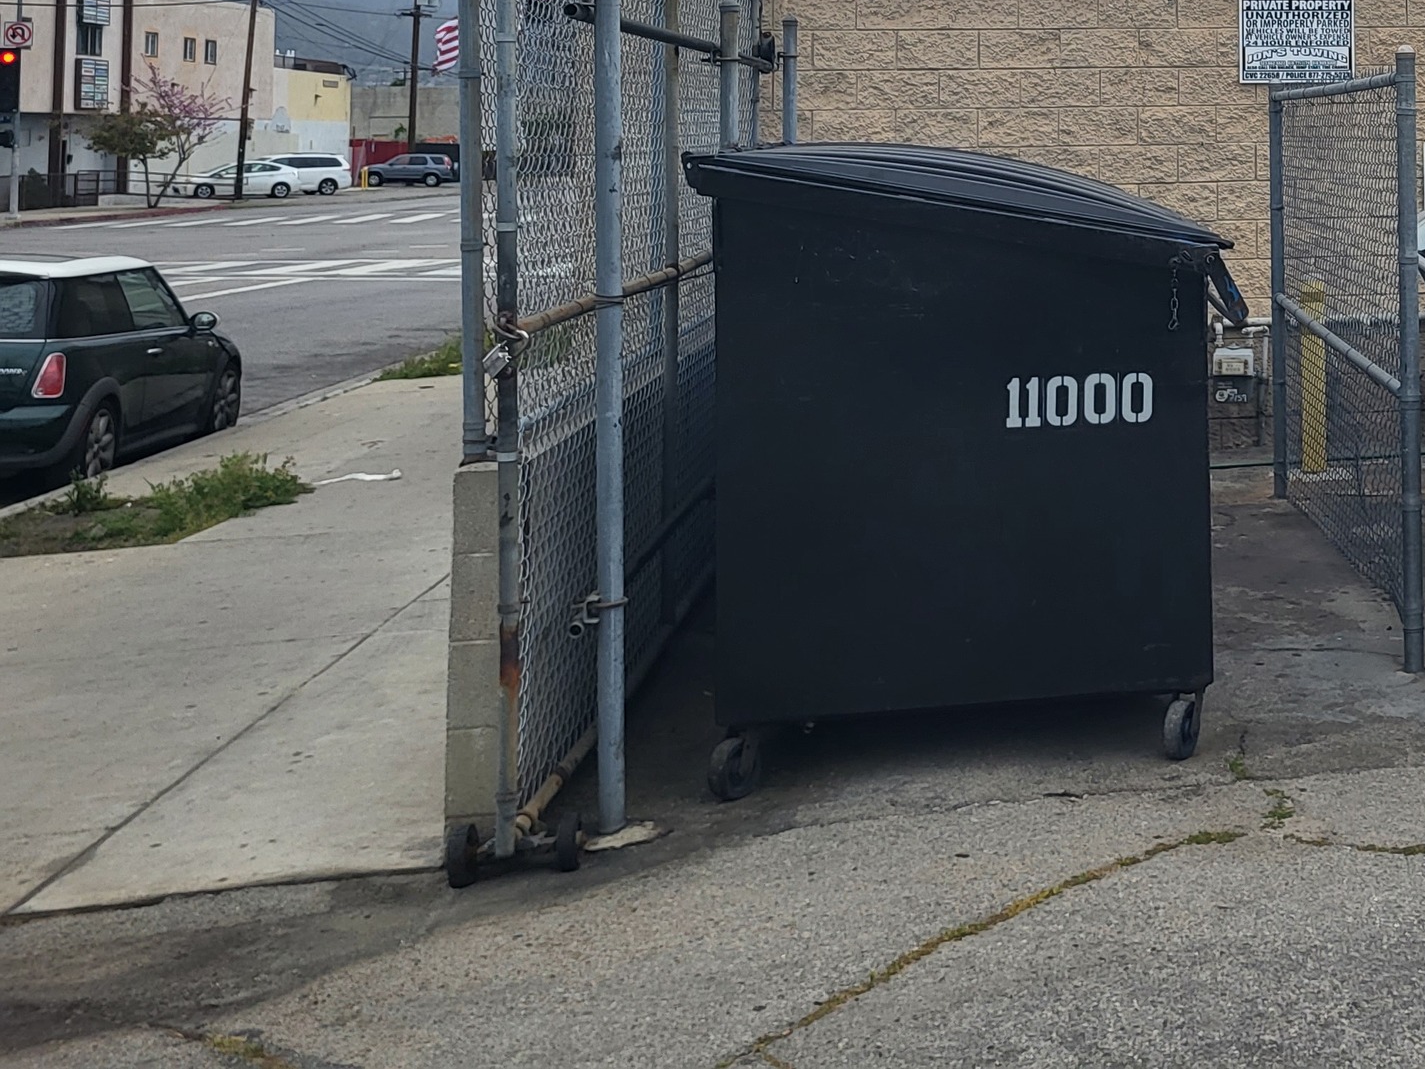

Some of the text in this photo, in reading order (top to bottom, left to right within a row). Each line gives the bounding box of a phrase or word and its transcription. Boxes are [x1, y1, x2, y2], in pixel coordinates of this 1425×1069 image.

[1243, 0, 1350, 10] PRIVATE PROPERTY
[1245, 12, 1349, 20] UNAUTHORIZED
[1245, 19, 1350, 28] OR IMPROPERLY PARKED
[1247, 47, 1348, 64] JON'S TOWING
[1006, 372, 1153, 428] 11000
